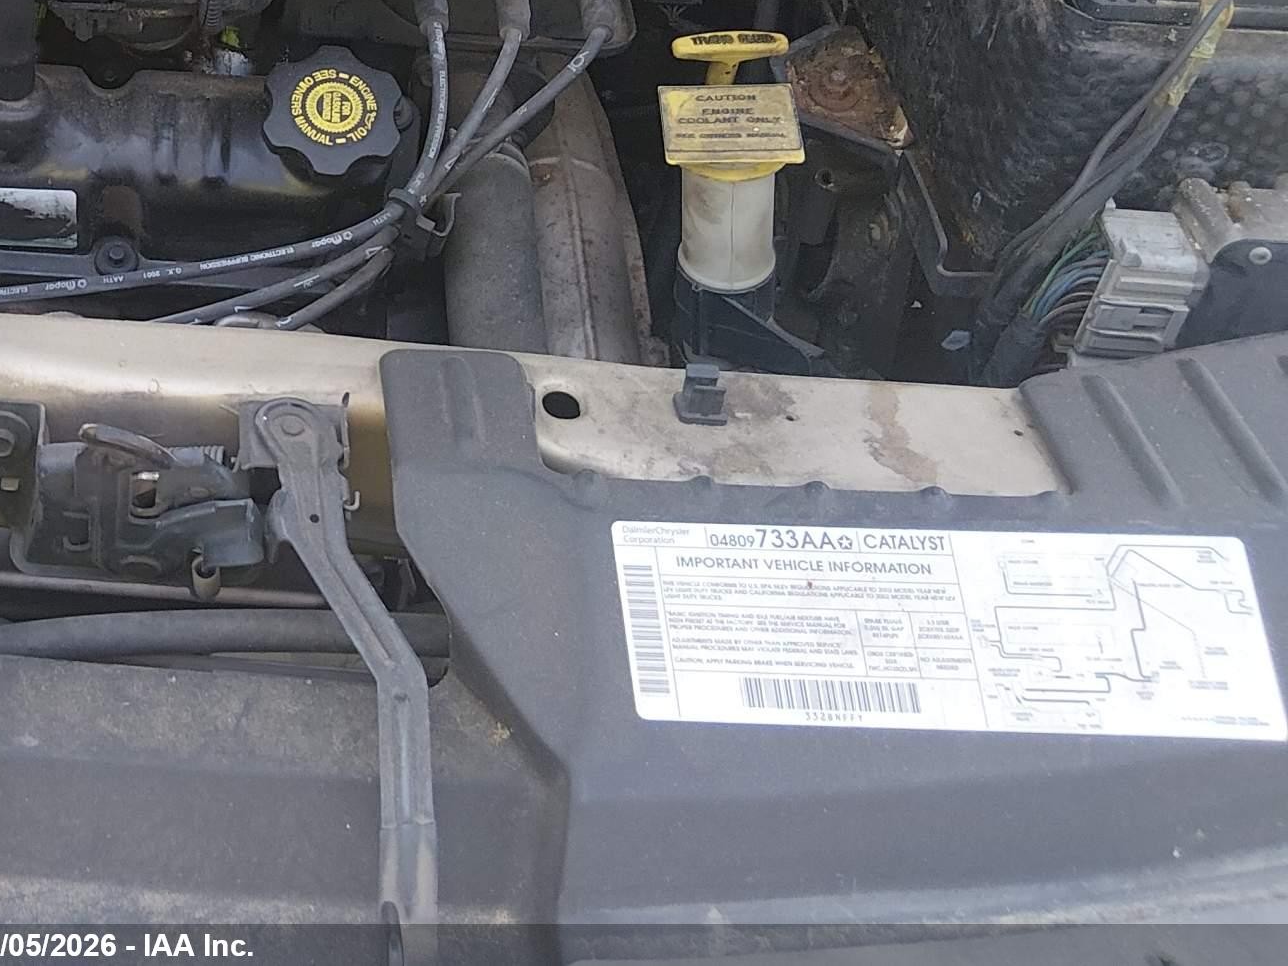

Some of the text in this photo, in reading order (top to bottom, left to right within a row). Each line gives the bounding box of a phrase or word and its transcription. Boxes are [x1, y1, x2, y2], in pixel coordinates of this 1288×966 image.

[695, 94, 756, 102] CAUTION
[291, 69, 337, 146] SEE OWNERS MANUAL
[347, 75, 378, 142] ENGINE OIL
[746, 116, 782, 125] ONLY
[312, 235, 343, 248] Mopar
[249, 247, 295, 262] ELECTRONIC
[200, 256, 249, 270] SUPPRESSION
[45, 280, 76, 292] Mopar
[622, 526, 689, 536] DaimlerChrysler
[624, 535, 675, 545] Corporation
[863, 533, 945, 551] CATALYST
[676, 555, 932, 575] IMPORTANT VEHICLE INFORMATION
